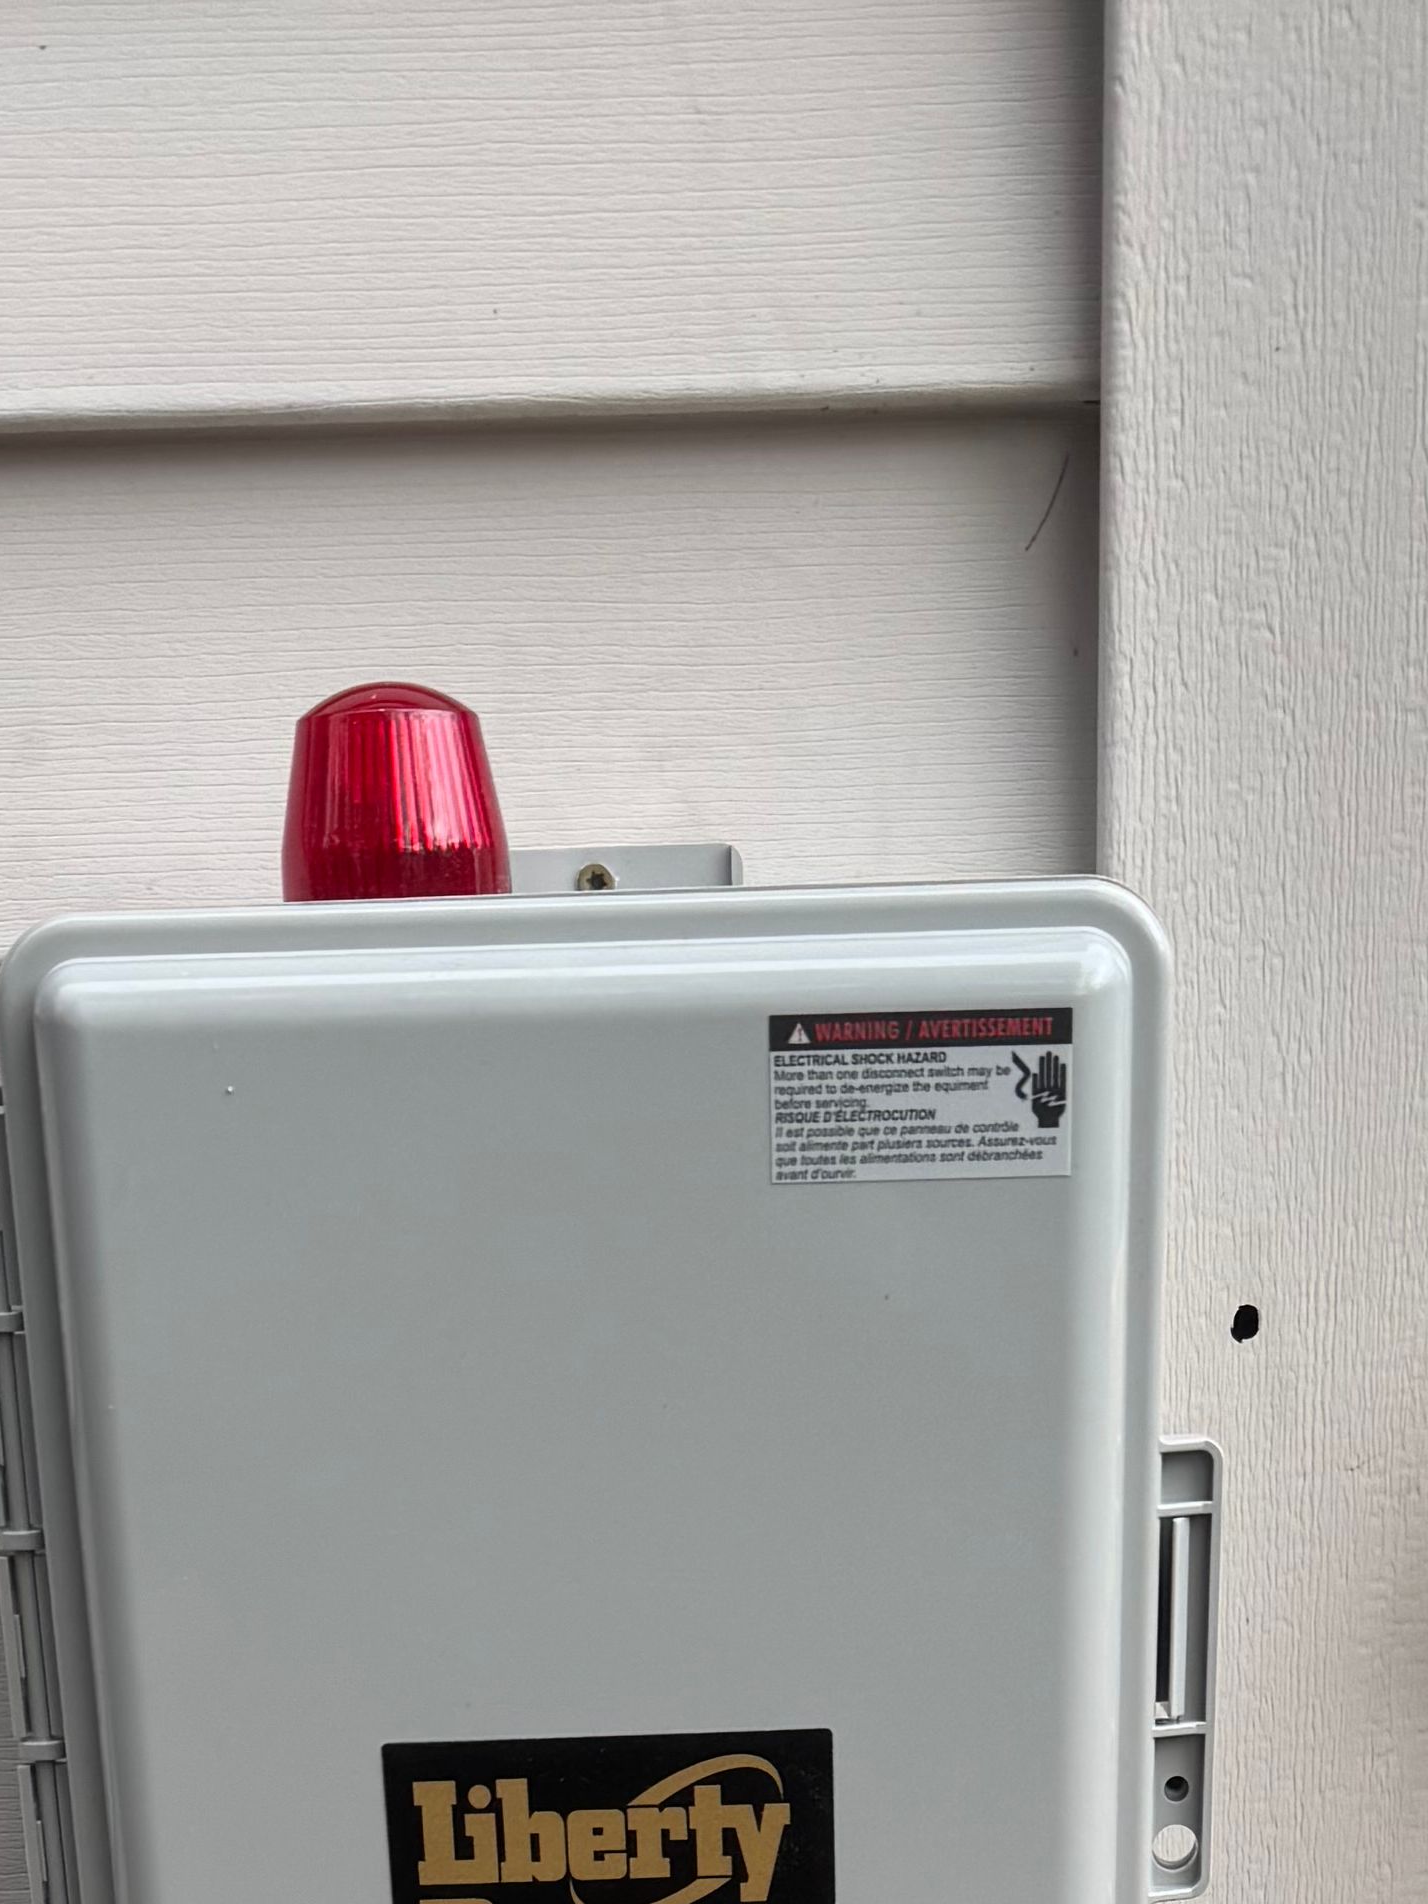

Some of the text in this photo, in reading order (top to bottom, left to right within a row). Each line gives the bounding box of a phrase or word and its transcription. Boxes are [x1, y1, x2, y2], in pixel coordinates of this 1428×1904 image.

[814, 1017, 1054, 1042] WARNING / AVERTISSEMENT
[774, 1051, 947, 1067] ELECTRICAL SHOCK HAZARD
[774, 1065, 1011, 1081] More than one disconnect switch may be
[774, 1085, 822, 1096] required
[825, 1085, 837, 1095] to
[840, 1083, 909, 1096] de-energize
[912, 1081, 931, 1092] the
[774, 1098, 870, 1112] before servicing.
[774, 1111, 821, 1123] RISQUE
[785, 1127, 805, 1138] est
[806, 1125, 855, 1139] possible
[857, 1127, 880, 1138] que
[883, 1126, 898, 1136] ce
[900, 1125, 952, 1137] panneau
[954, 1122, 970, 1134] de
[972, 1120, 1019, 1134] contrôle
[776, 1142, 796, 1152] soit
[977, 1135, 1057, 1148] Assurez-vous
[775, 1157, 797, 1168] que
[800, 1155, 837, 1166] toutes
[839, 1154, 857, 1165] les
[859, 1151, 936, 1164] alimentations
[940, 1151, 965, 1162] sont
[775, 1169, 807, 1180] avant
[412, 1777, 791, 1902] Liberty
